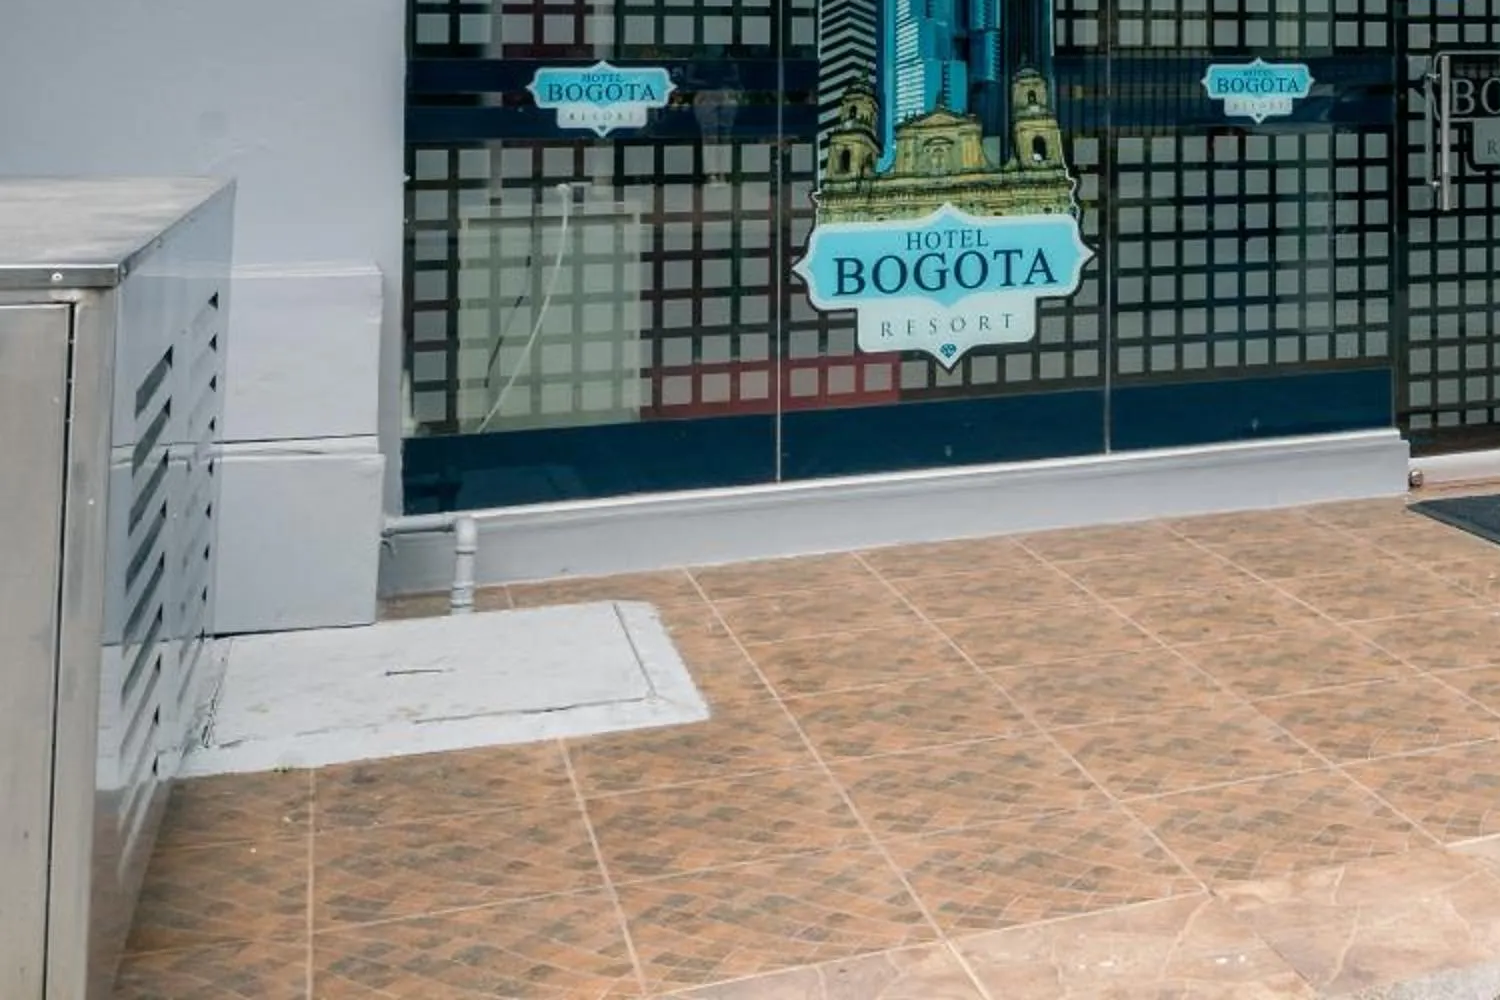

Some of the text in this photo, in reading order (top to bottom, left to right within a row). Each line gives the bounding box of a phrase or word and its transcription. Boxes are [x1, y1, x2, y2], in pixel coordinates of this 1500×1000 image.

[547, 83, 657, 102] BOGOTA
[1216, 77, 1300, 94] BOGOTA
[906, 228, 990, 251] HOTEL
[831, 247, 1059, 298] BOGOTA
[880, 312, 1015, 338] RESORT
